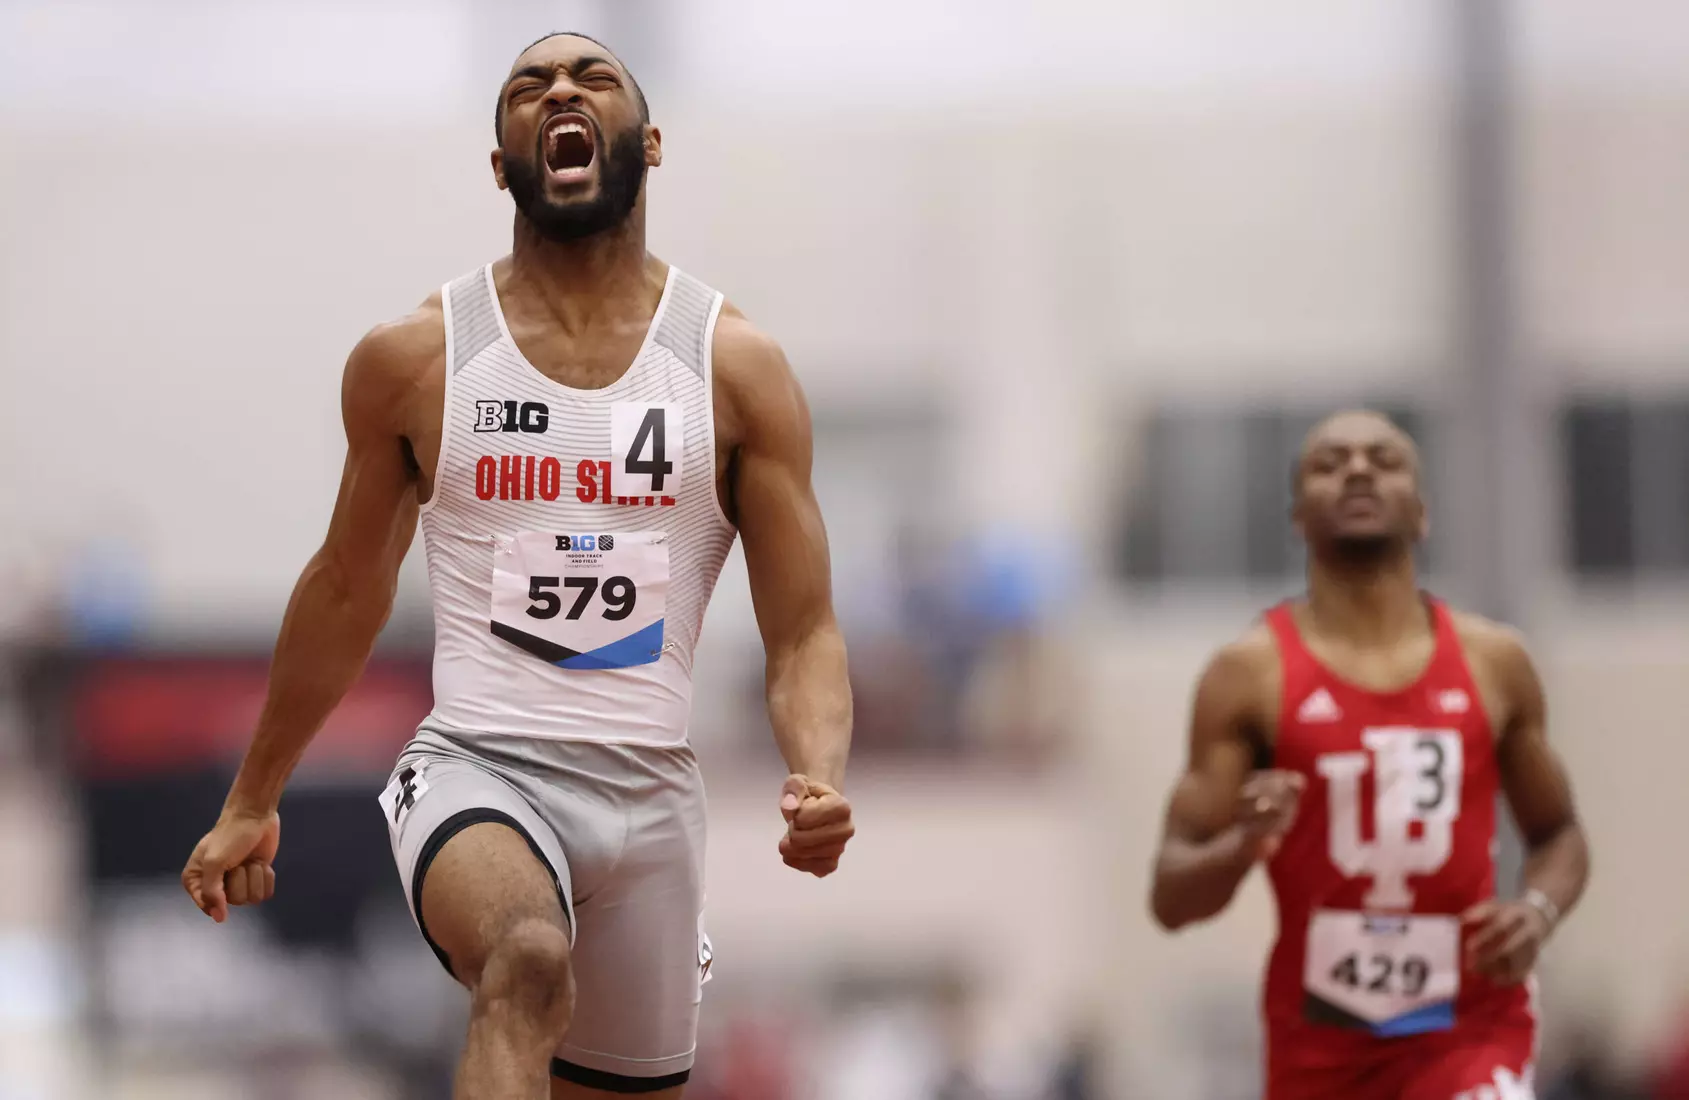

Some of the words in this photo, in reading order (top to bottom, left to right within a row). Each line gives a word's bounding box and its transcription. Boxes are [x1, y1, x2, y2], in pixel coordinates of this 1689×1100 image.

[625, 408, 673, 491] 4
[475, 455, 561, 502] OHIO
[525, 575, 637, 621] 579
[1414, 738, 1447, 811] 3
[1329, 952, 1431, 996] 429
